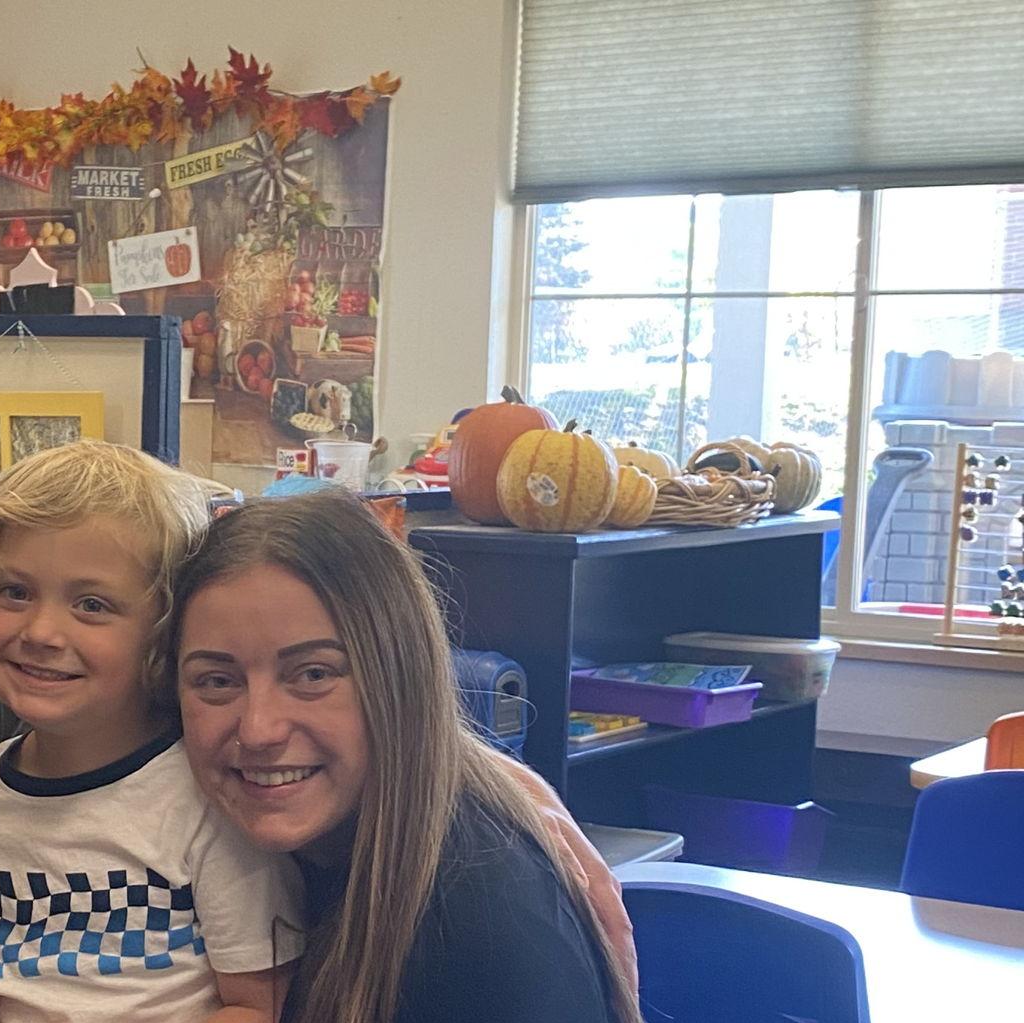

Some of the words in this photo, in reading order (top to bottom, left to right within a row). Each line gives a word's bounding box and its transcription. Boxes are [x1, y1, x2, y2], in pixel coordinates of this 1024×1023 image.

[170, 155, 212, 182] FRESH
[77, 169, 140, 187] MARKET
[86, 186, 130, 197] FRESH
[279, 451, 295, 469] Rice
